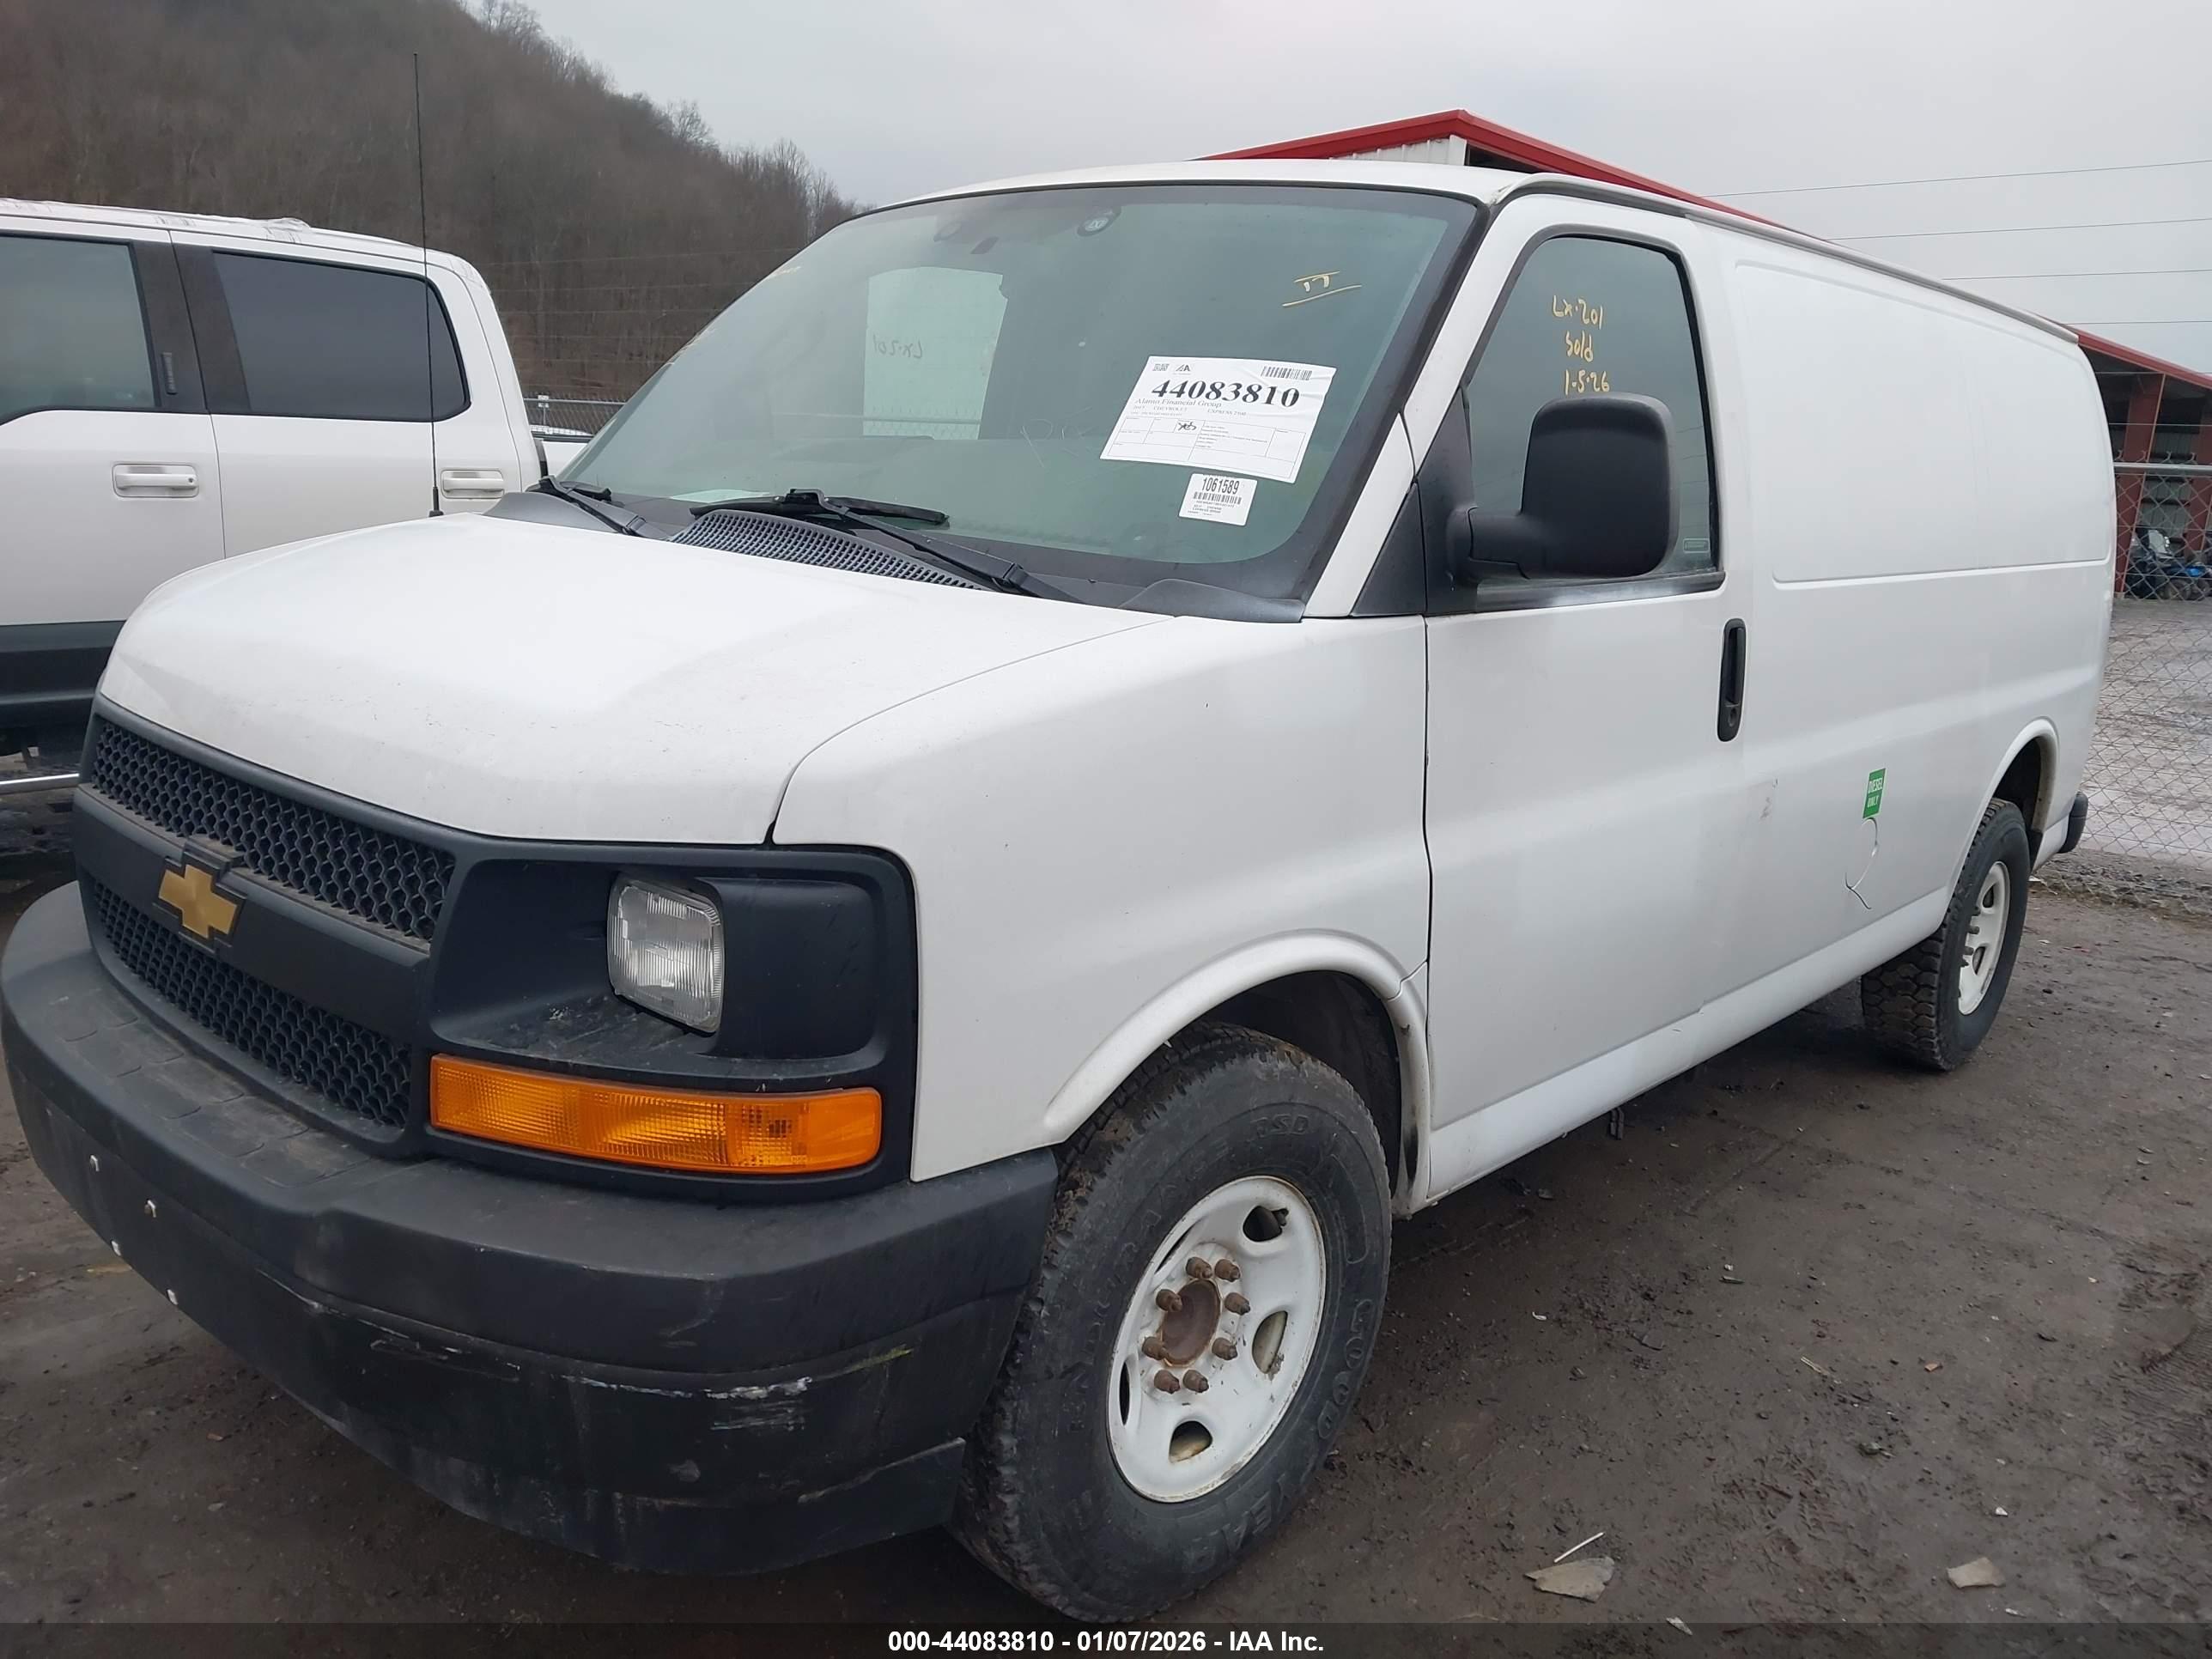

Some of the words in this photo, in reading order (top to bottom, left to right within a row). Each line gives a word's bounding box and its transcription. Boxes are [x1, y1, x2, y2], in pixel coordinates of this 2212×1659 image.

[1151, 379, 1301, 408] 44083810
[1197, 400, 1222, 409] Group
[1202, 477, 1240, 495] 1061589
